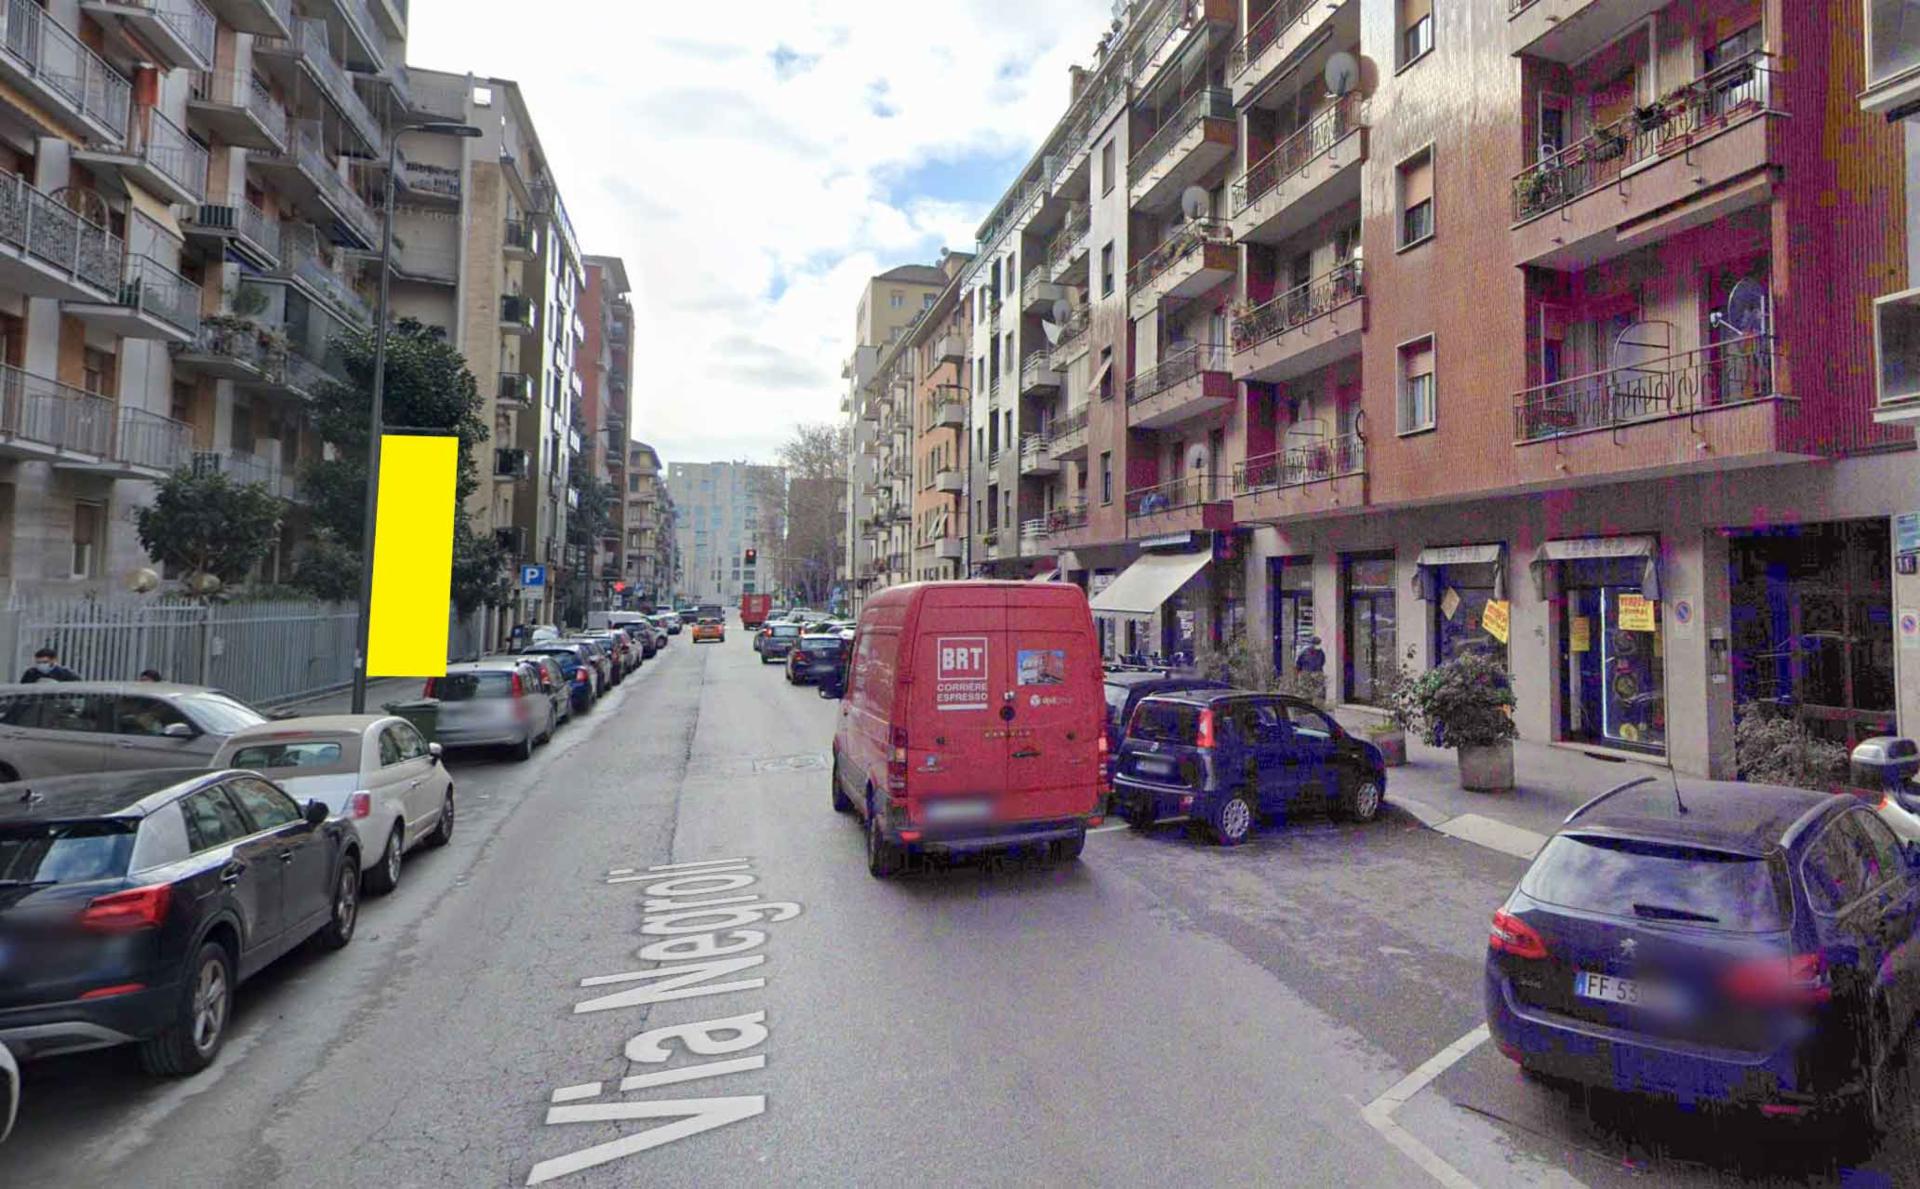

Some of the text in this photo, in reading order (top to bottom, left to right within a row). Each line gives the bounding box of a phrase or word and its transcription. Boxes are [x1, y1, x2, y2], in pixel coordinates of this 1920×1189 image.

[525, 568, 539, 584] P
[942, 647, 983, 671] BRT
[936, 682, 988, 692] CORRIERE
[936, 692, 988, 702] ESPRESSO
[1587, 975, 1609, 996] FF
